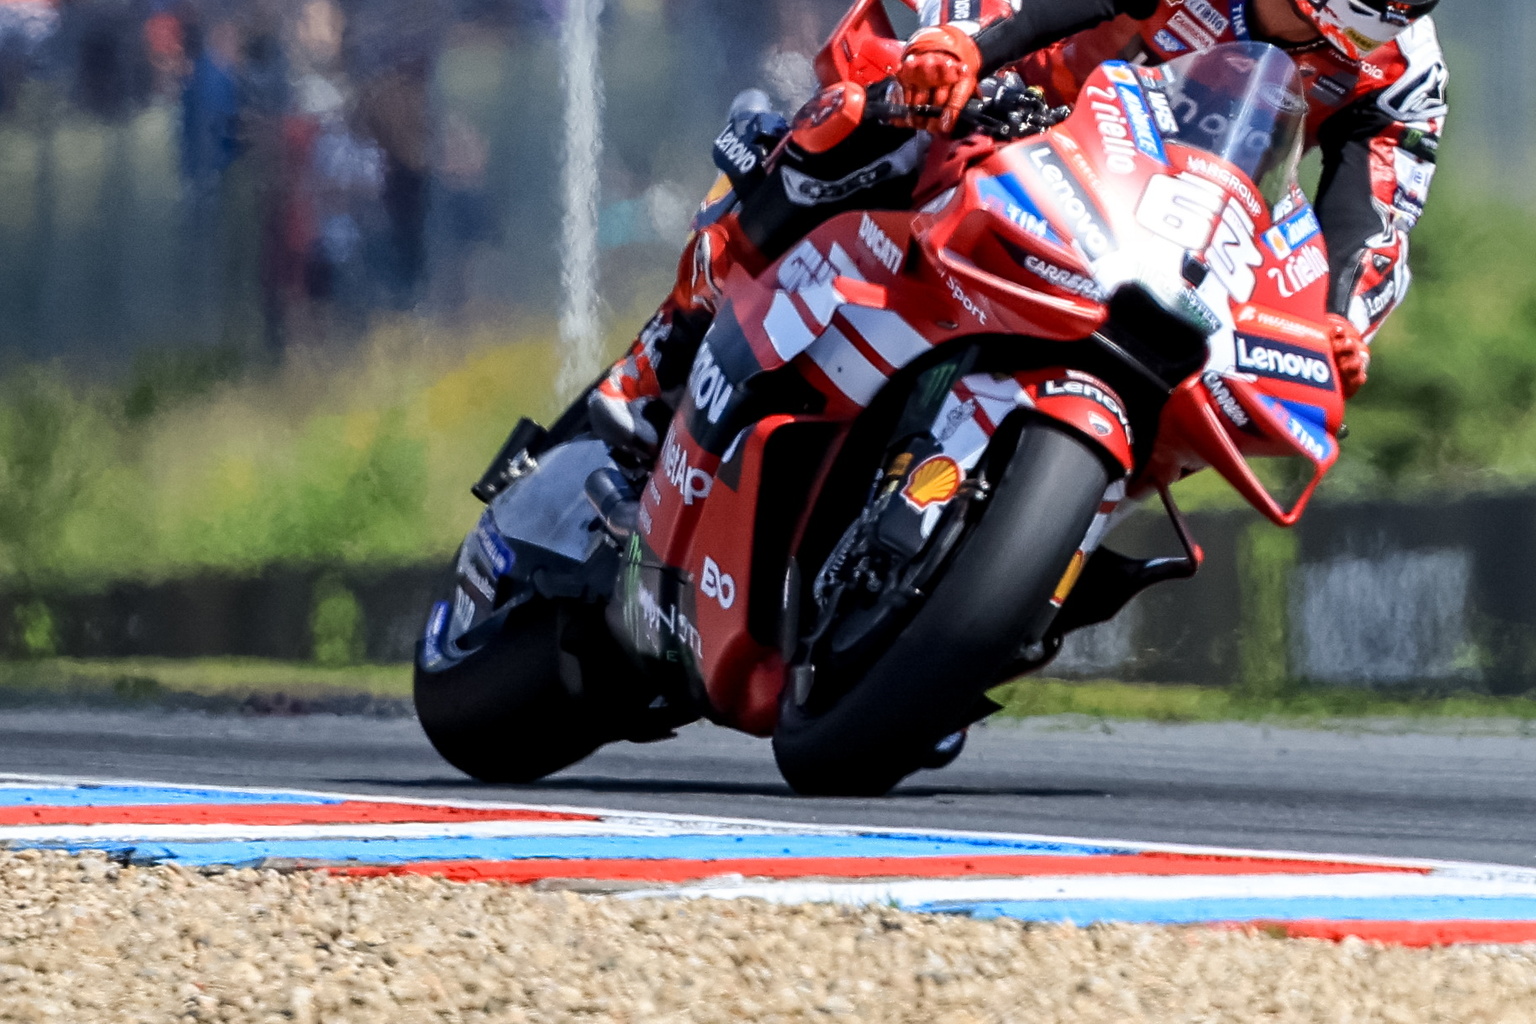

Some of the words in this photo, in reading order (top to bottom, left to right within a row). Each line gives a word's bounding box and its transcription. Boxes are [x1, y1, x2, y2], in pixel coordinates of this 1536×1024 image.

[1232, 3, 1247, 36] TIM
[713, 124, 757, 175] Lenovo
[1007, 202, 1049, 238] TIM
[1029, 146, 1108, 259] Lenovo
[858, 210, 904, 275] DUCATI
[1134, 171, 1265, 305] 63
[946, 276, 987, 325] Sport
[1236, 336, 1330, 384] Lenovo
[1288, 417, 1324, 461] TIM
